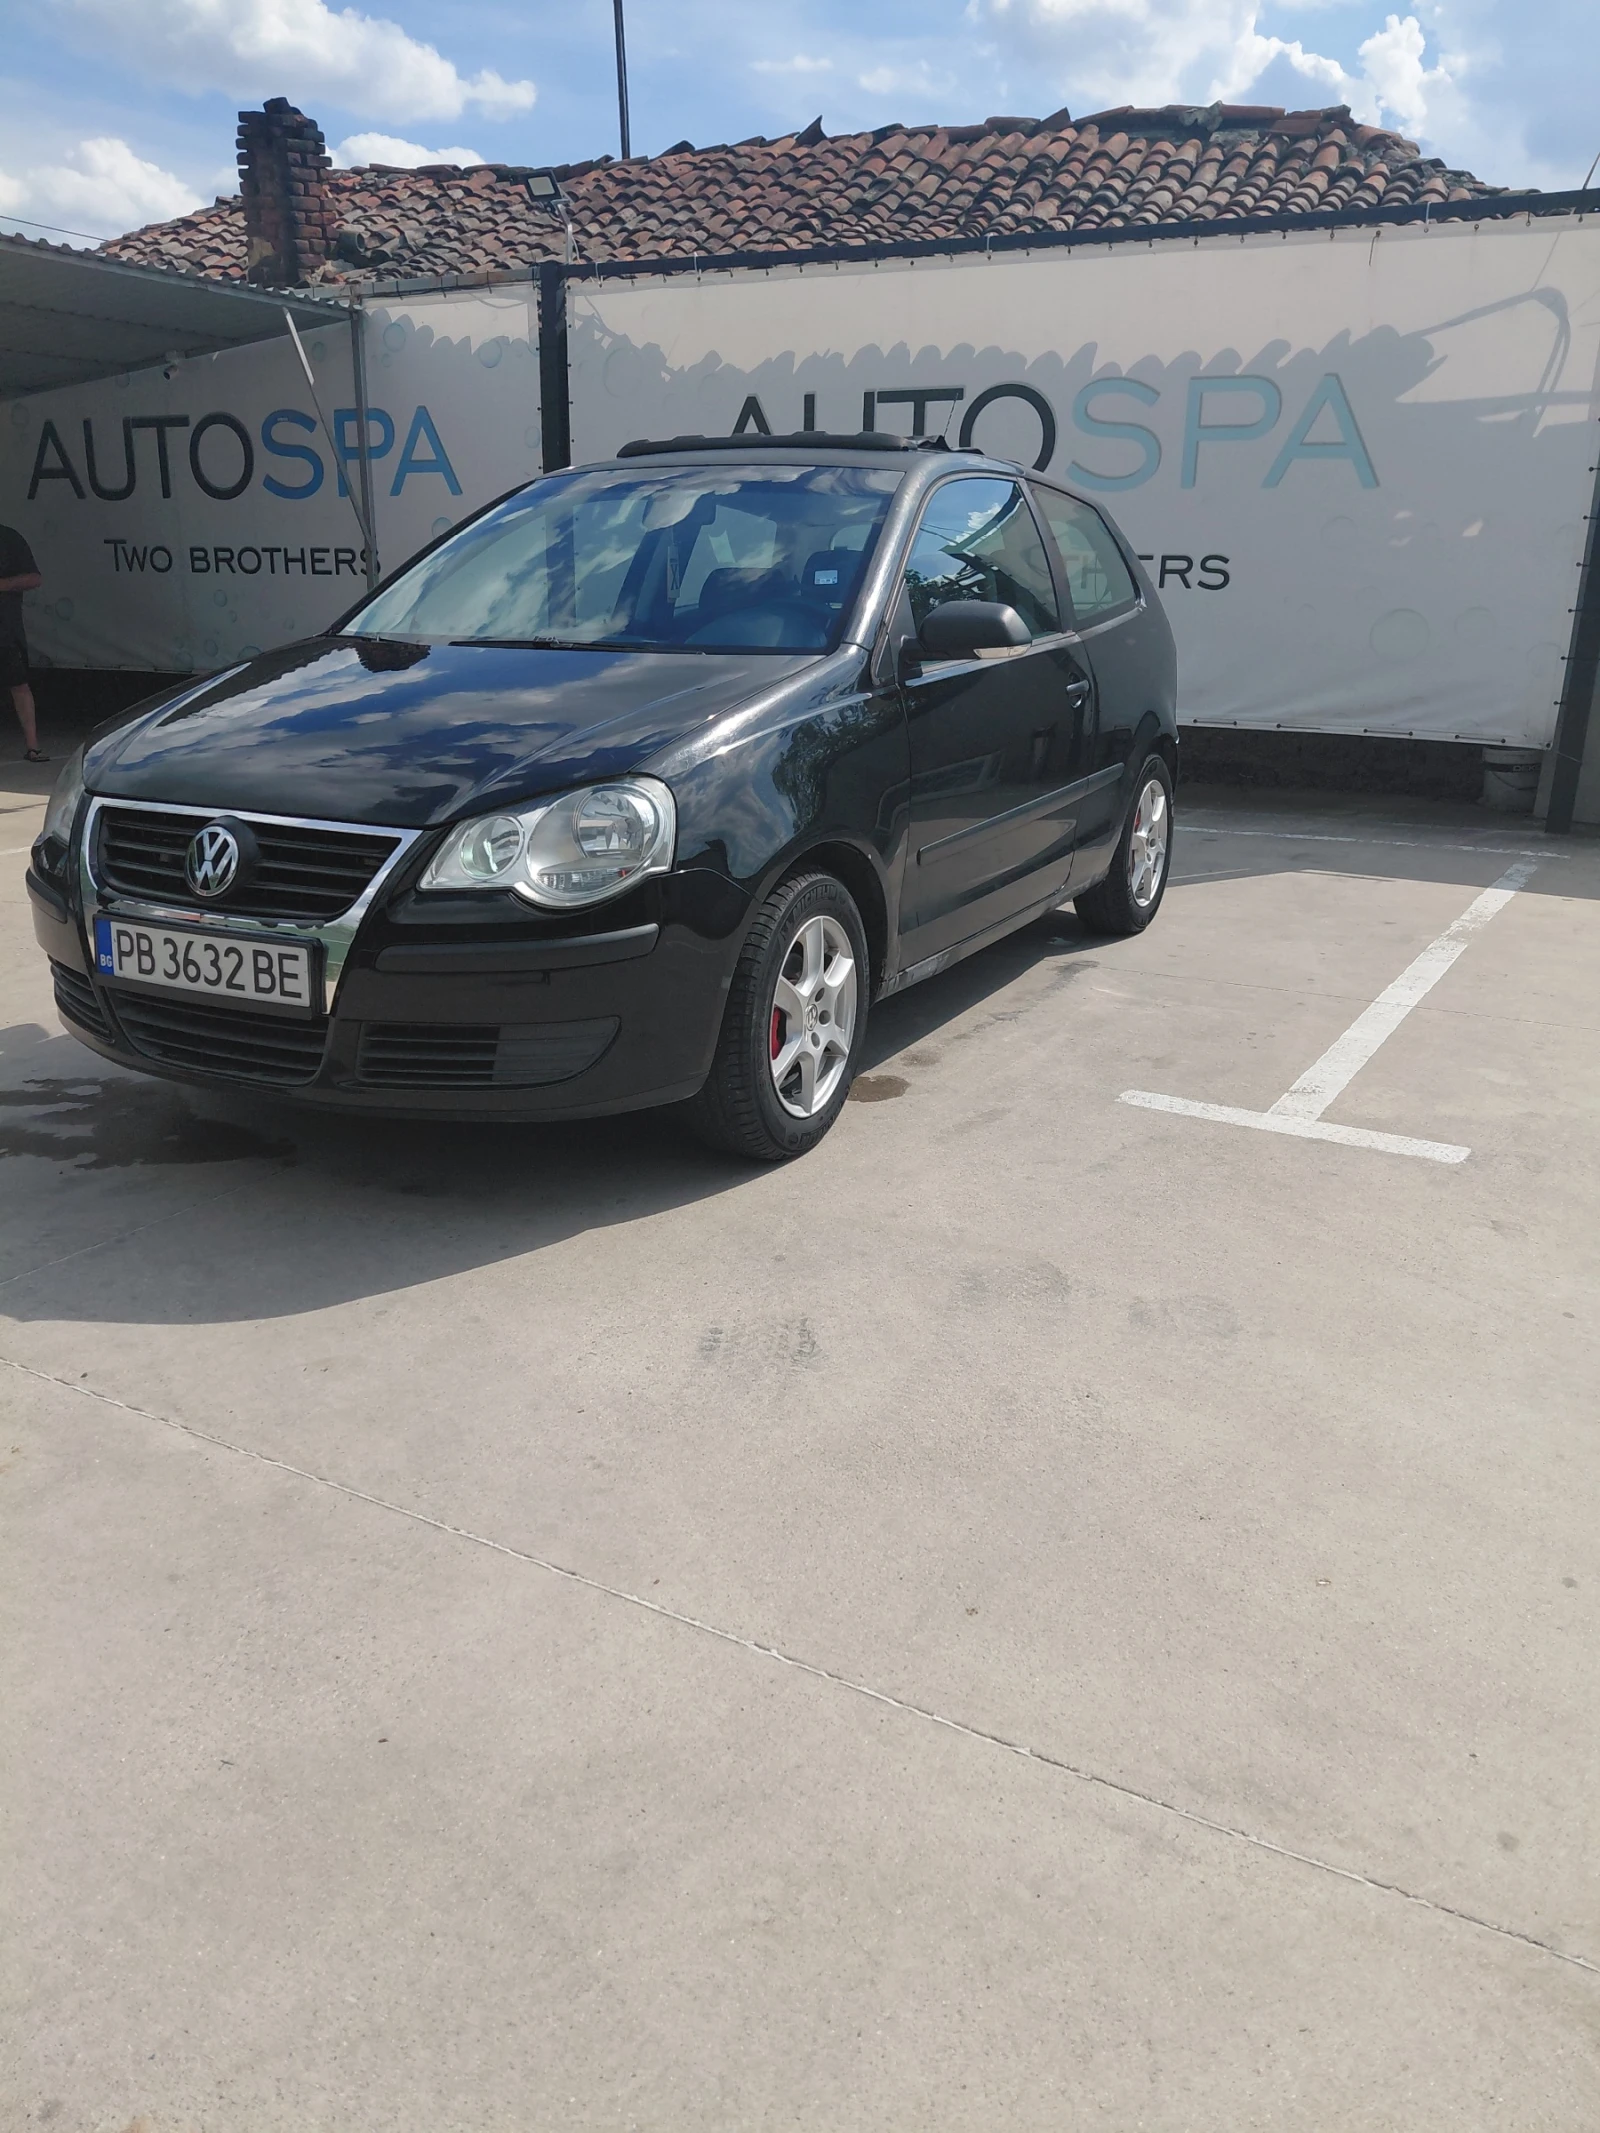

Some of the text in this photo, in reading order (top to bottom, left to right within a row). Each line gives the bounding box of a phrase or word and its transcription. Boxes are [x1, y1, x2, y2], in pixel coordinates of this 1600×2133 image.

[27, 405, 463, 500] AUTOSPA
[100, 953, 113, 968] BG
[115, 929, 302, 999] PB 3632 BE
